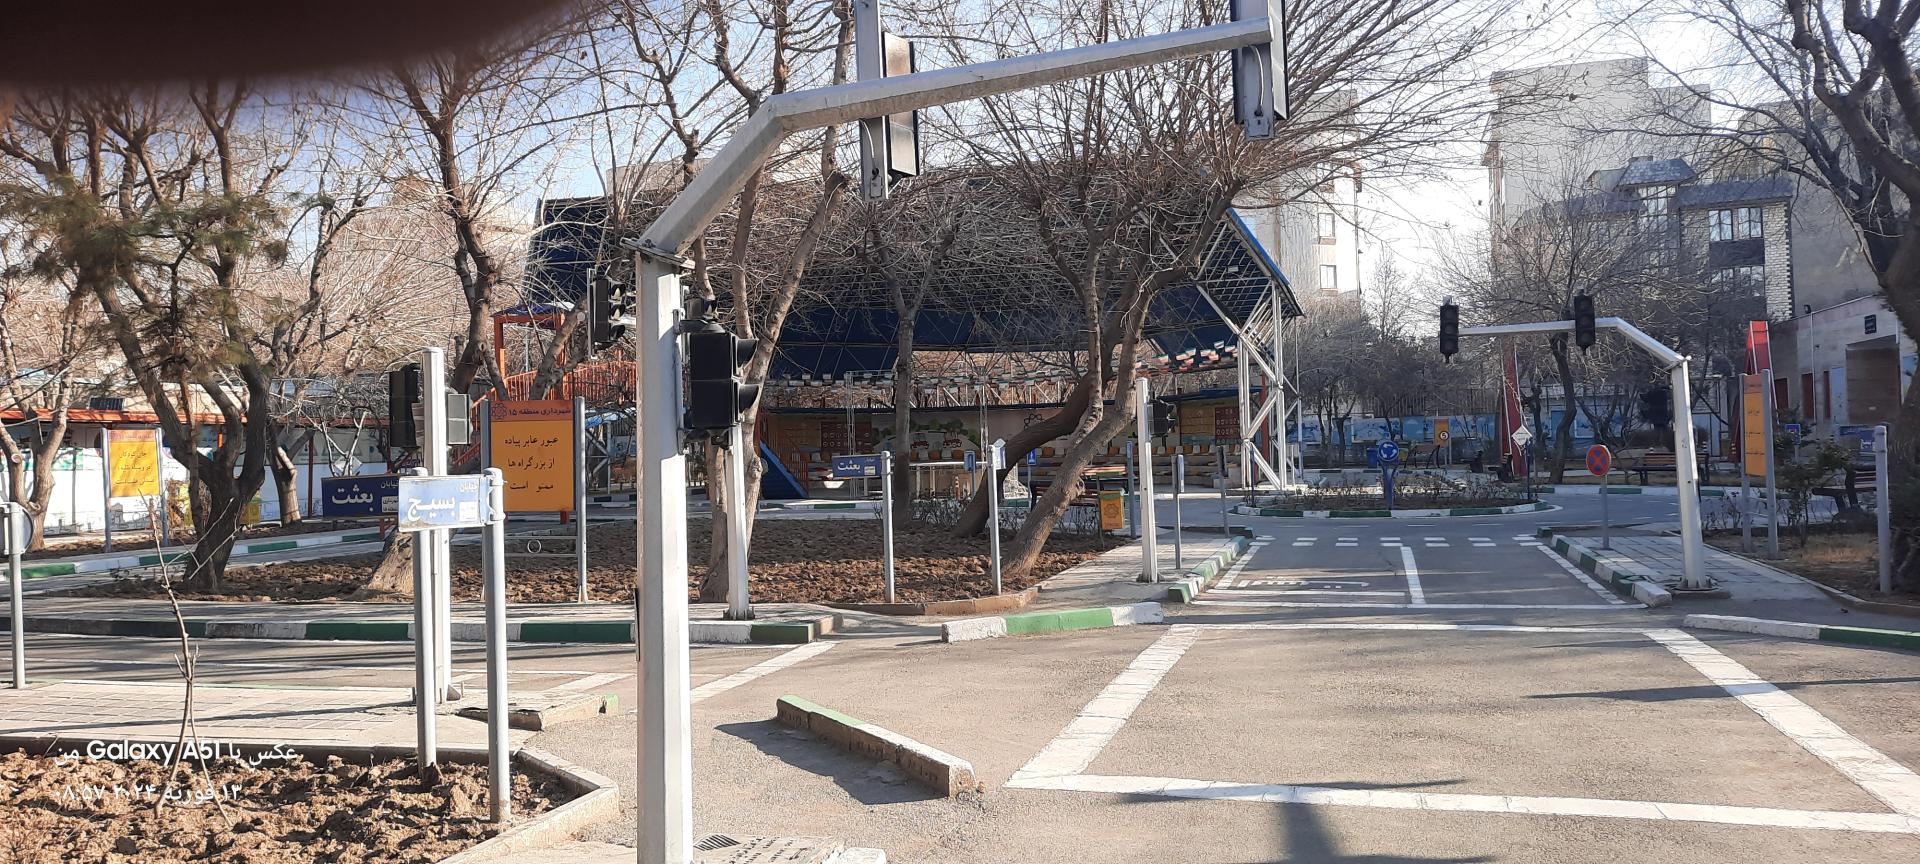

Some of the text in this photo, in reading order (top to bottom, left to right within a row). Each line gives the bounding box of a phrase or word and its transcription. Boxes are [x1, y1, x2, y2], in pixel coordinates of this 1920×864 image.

[508, 408, 518, 416] ۱۵
[541, 407, 572, 416] شهرداری
[505, 435, 559, 447] عبور عابر پیاده
[548, 458, 555, 469] از
[837, 459, 861, 473] بعثت
[509, 481, 529, 490] است
[331, 484, 374, 512] بعثت
[408, 497, 456, 522] بسیج
